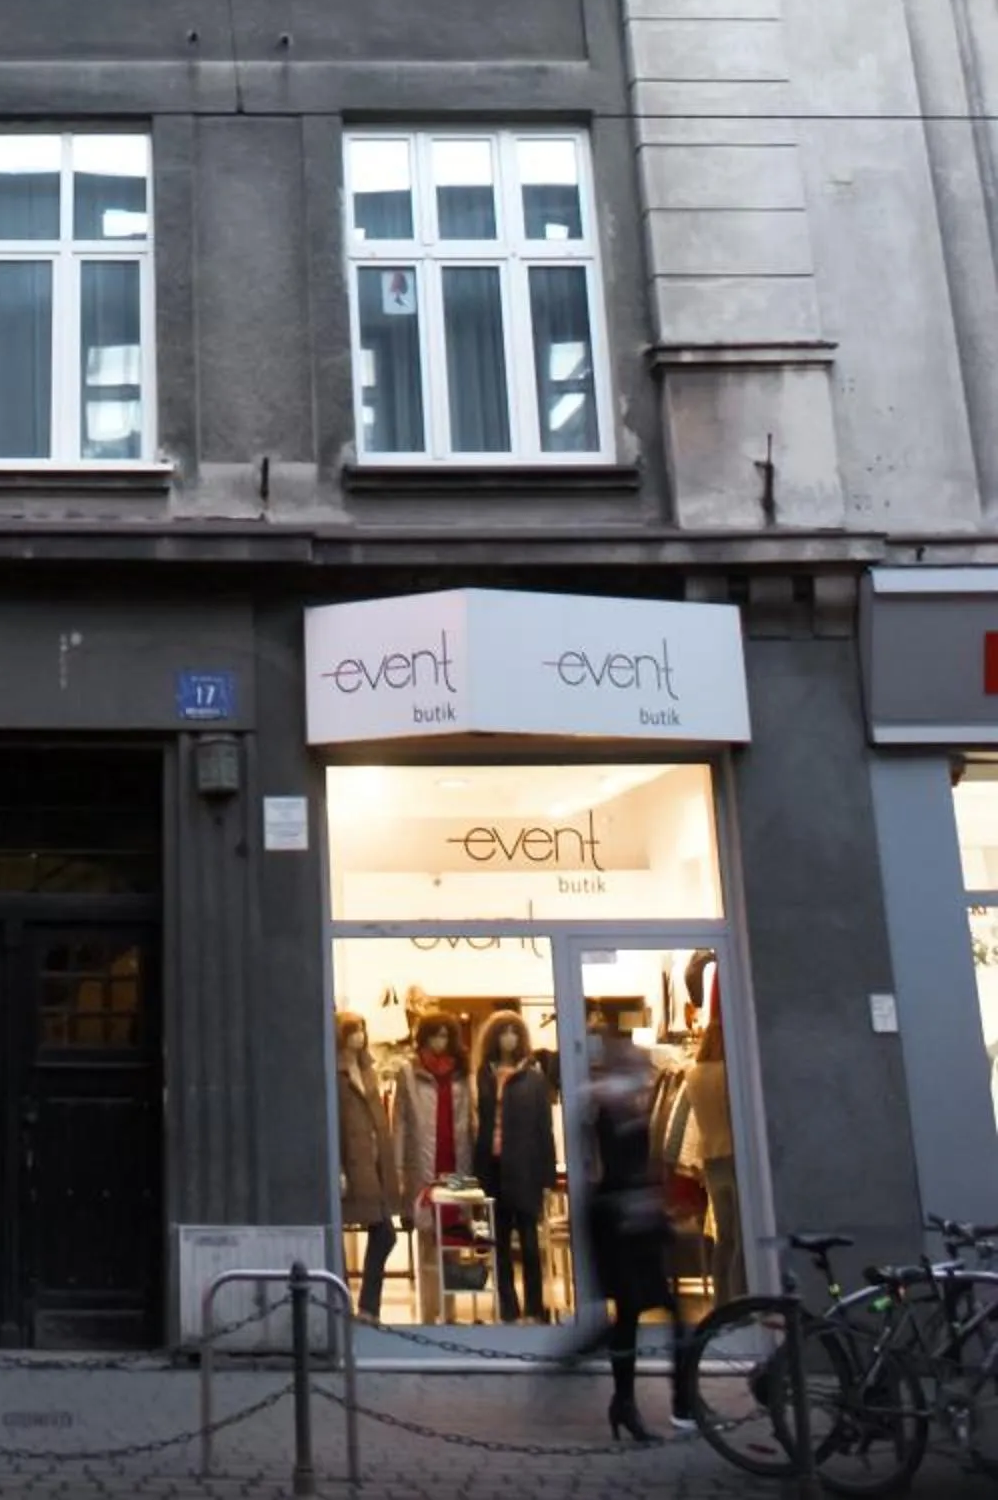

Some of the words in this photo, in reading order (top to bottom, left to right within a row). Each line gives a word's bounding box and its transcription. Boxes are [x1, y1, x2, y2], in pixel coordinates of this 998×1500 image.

[322, 629, 457, 693] event
[542, 638, 679, 700] event
[196, 684, 215, 707] 17
[413, 703, 456, 723] butik
[639, 707, 681, 726] butik
[447, 810, 605, 871] event
[558, 876, 607, 894] butik
